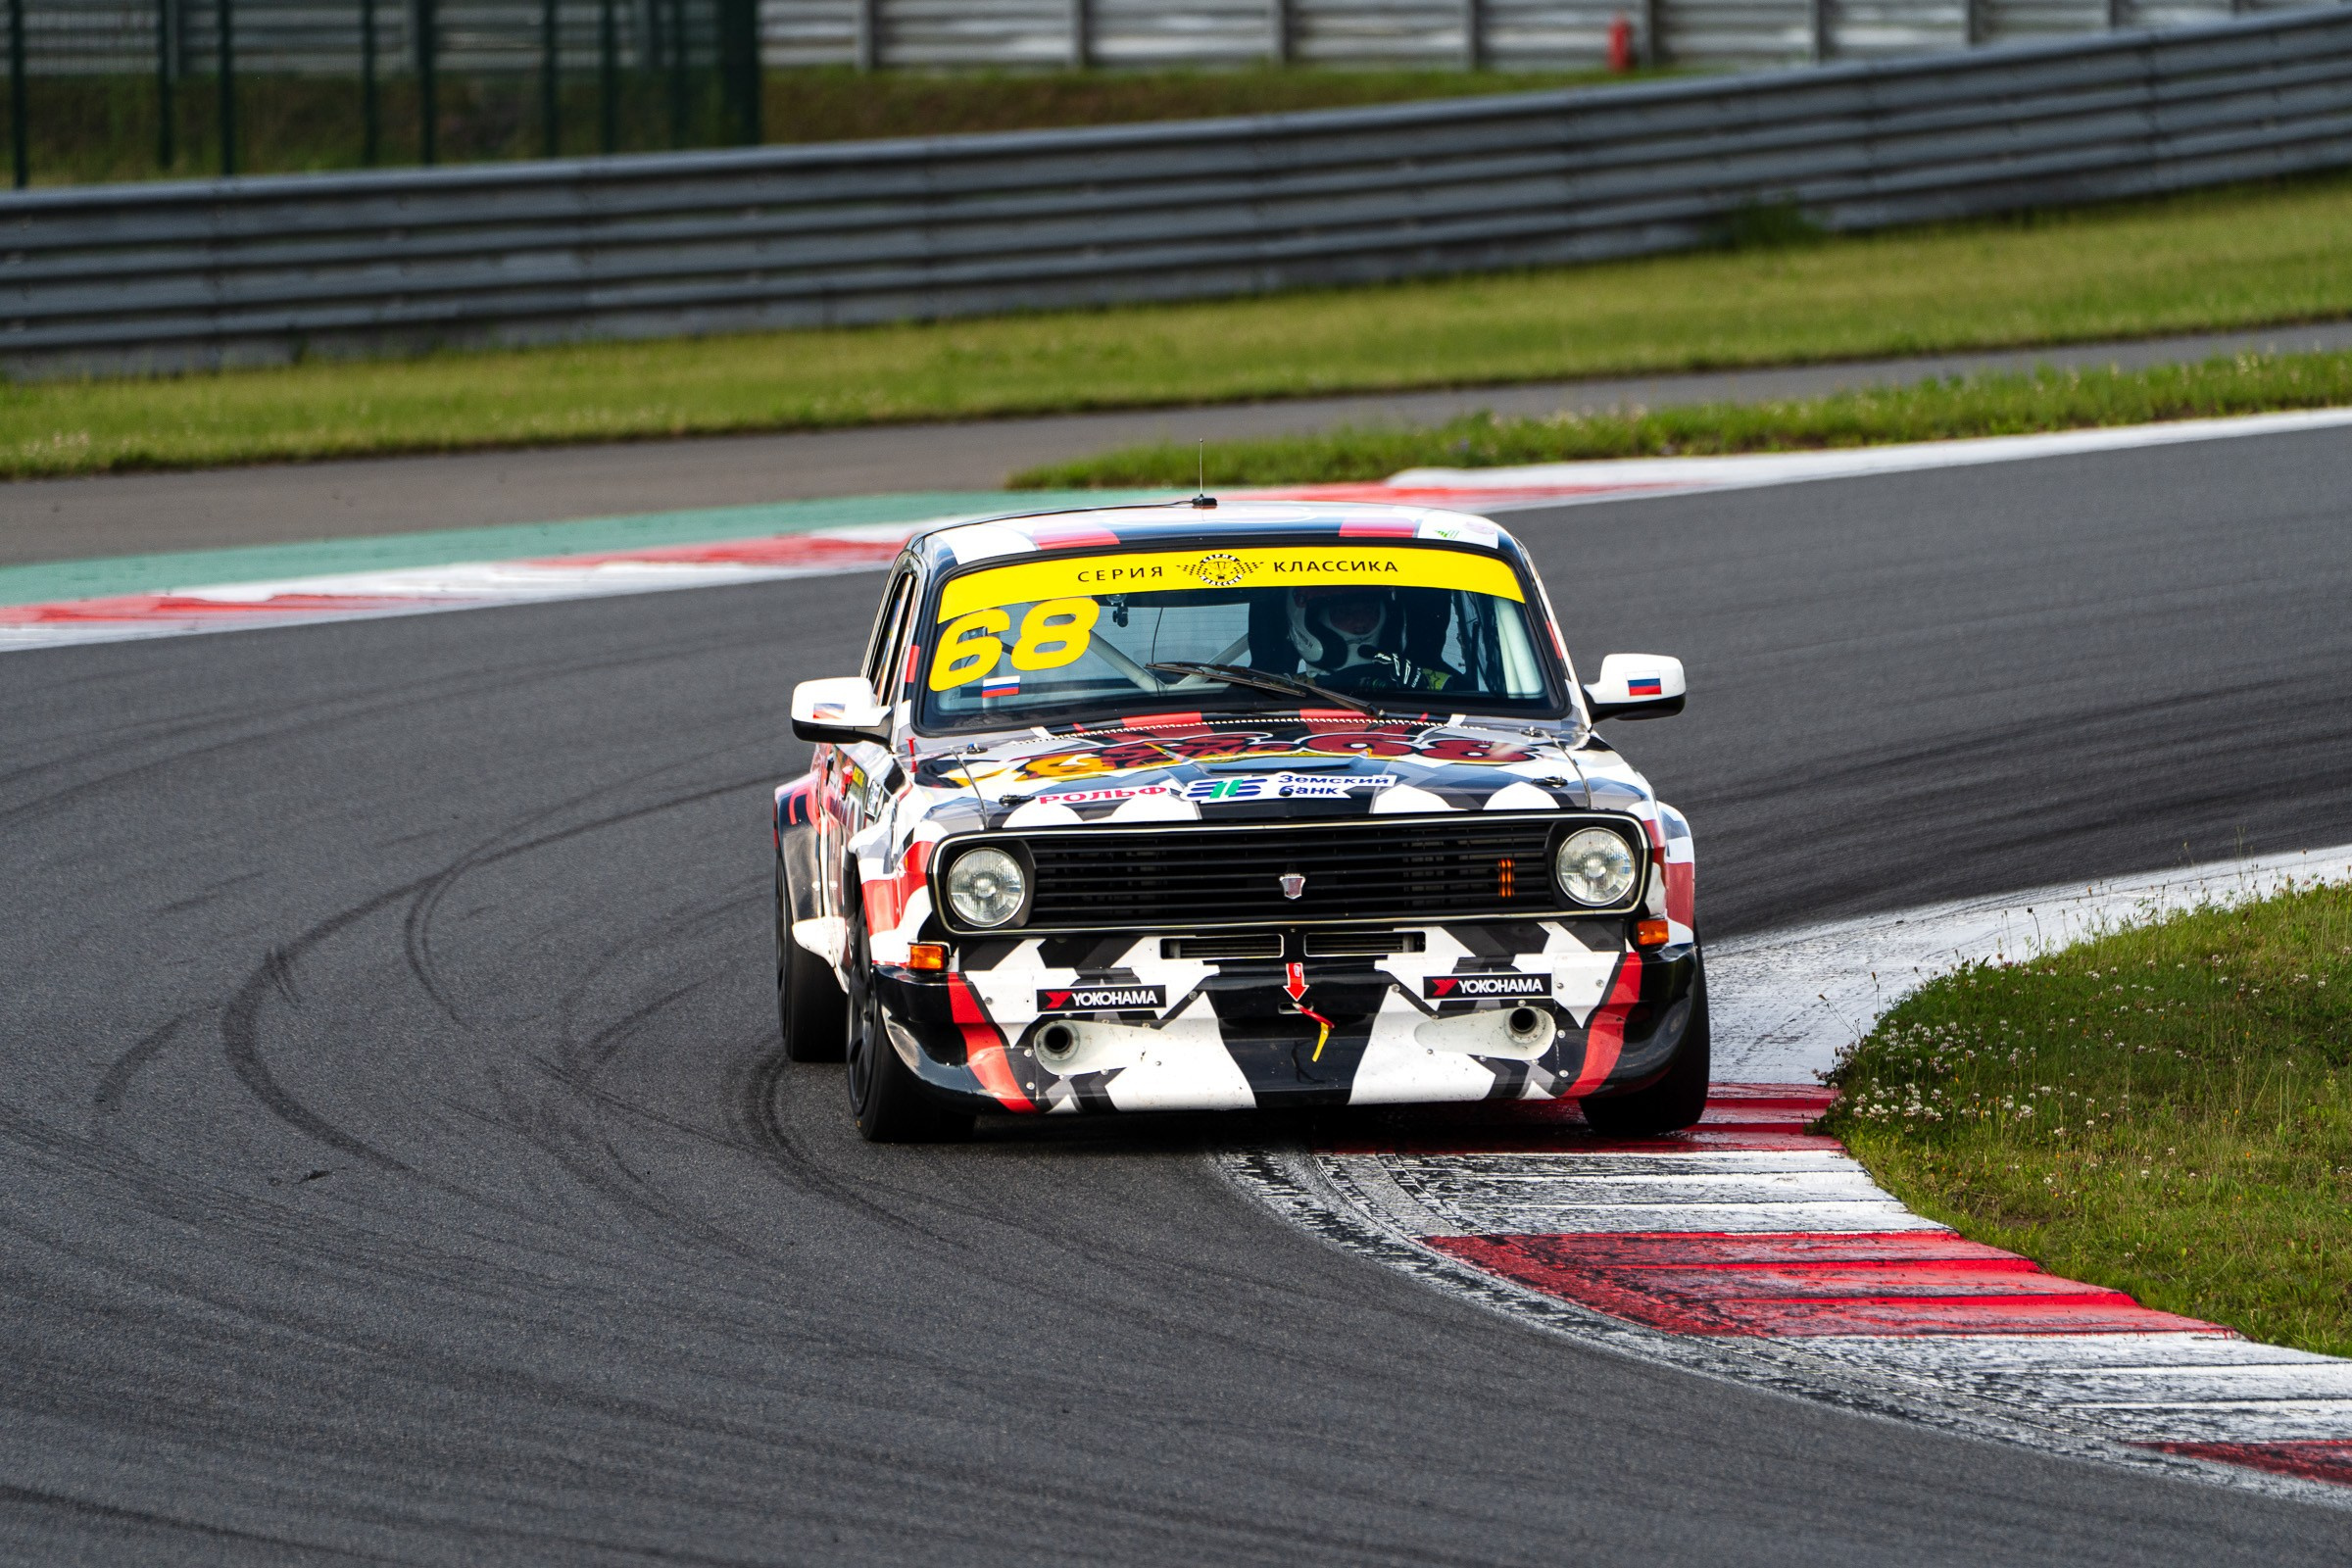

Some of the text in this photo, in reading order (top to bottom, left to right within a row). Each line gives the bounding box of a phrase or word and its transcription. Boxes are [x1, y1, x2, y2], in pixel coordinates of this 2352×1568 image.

[1077, 560, 1398, 583] СЕРИЯ КЛАССИКА
[929, 597, 1100, 692] 68
[1277, 774, 1390, 784] Земский
[1039, 784, 1168, 805] РОЛЬФ
[1278, 784, 1339, 796] банк
[1459, 978, 1544, 994] YOKOHAMA
[1072, 990, 1158, 1006] YOKOHAMA
